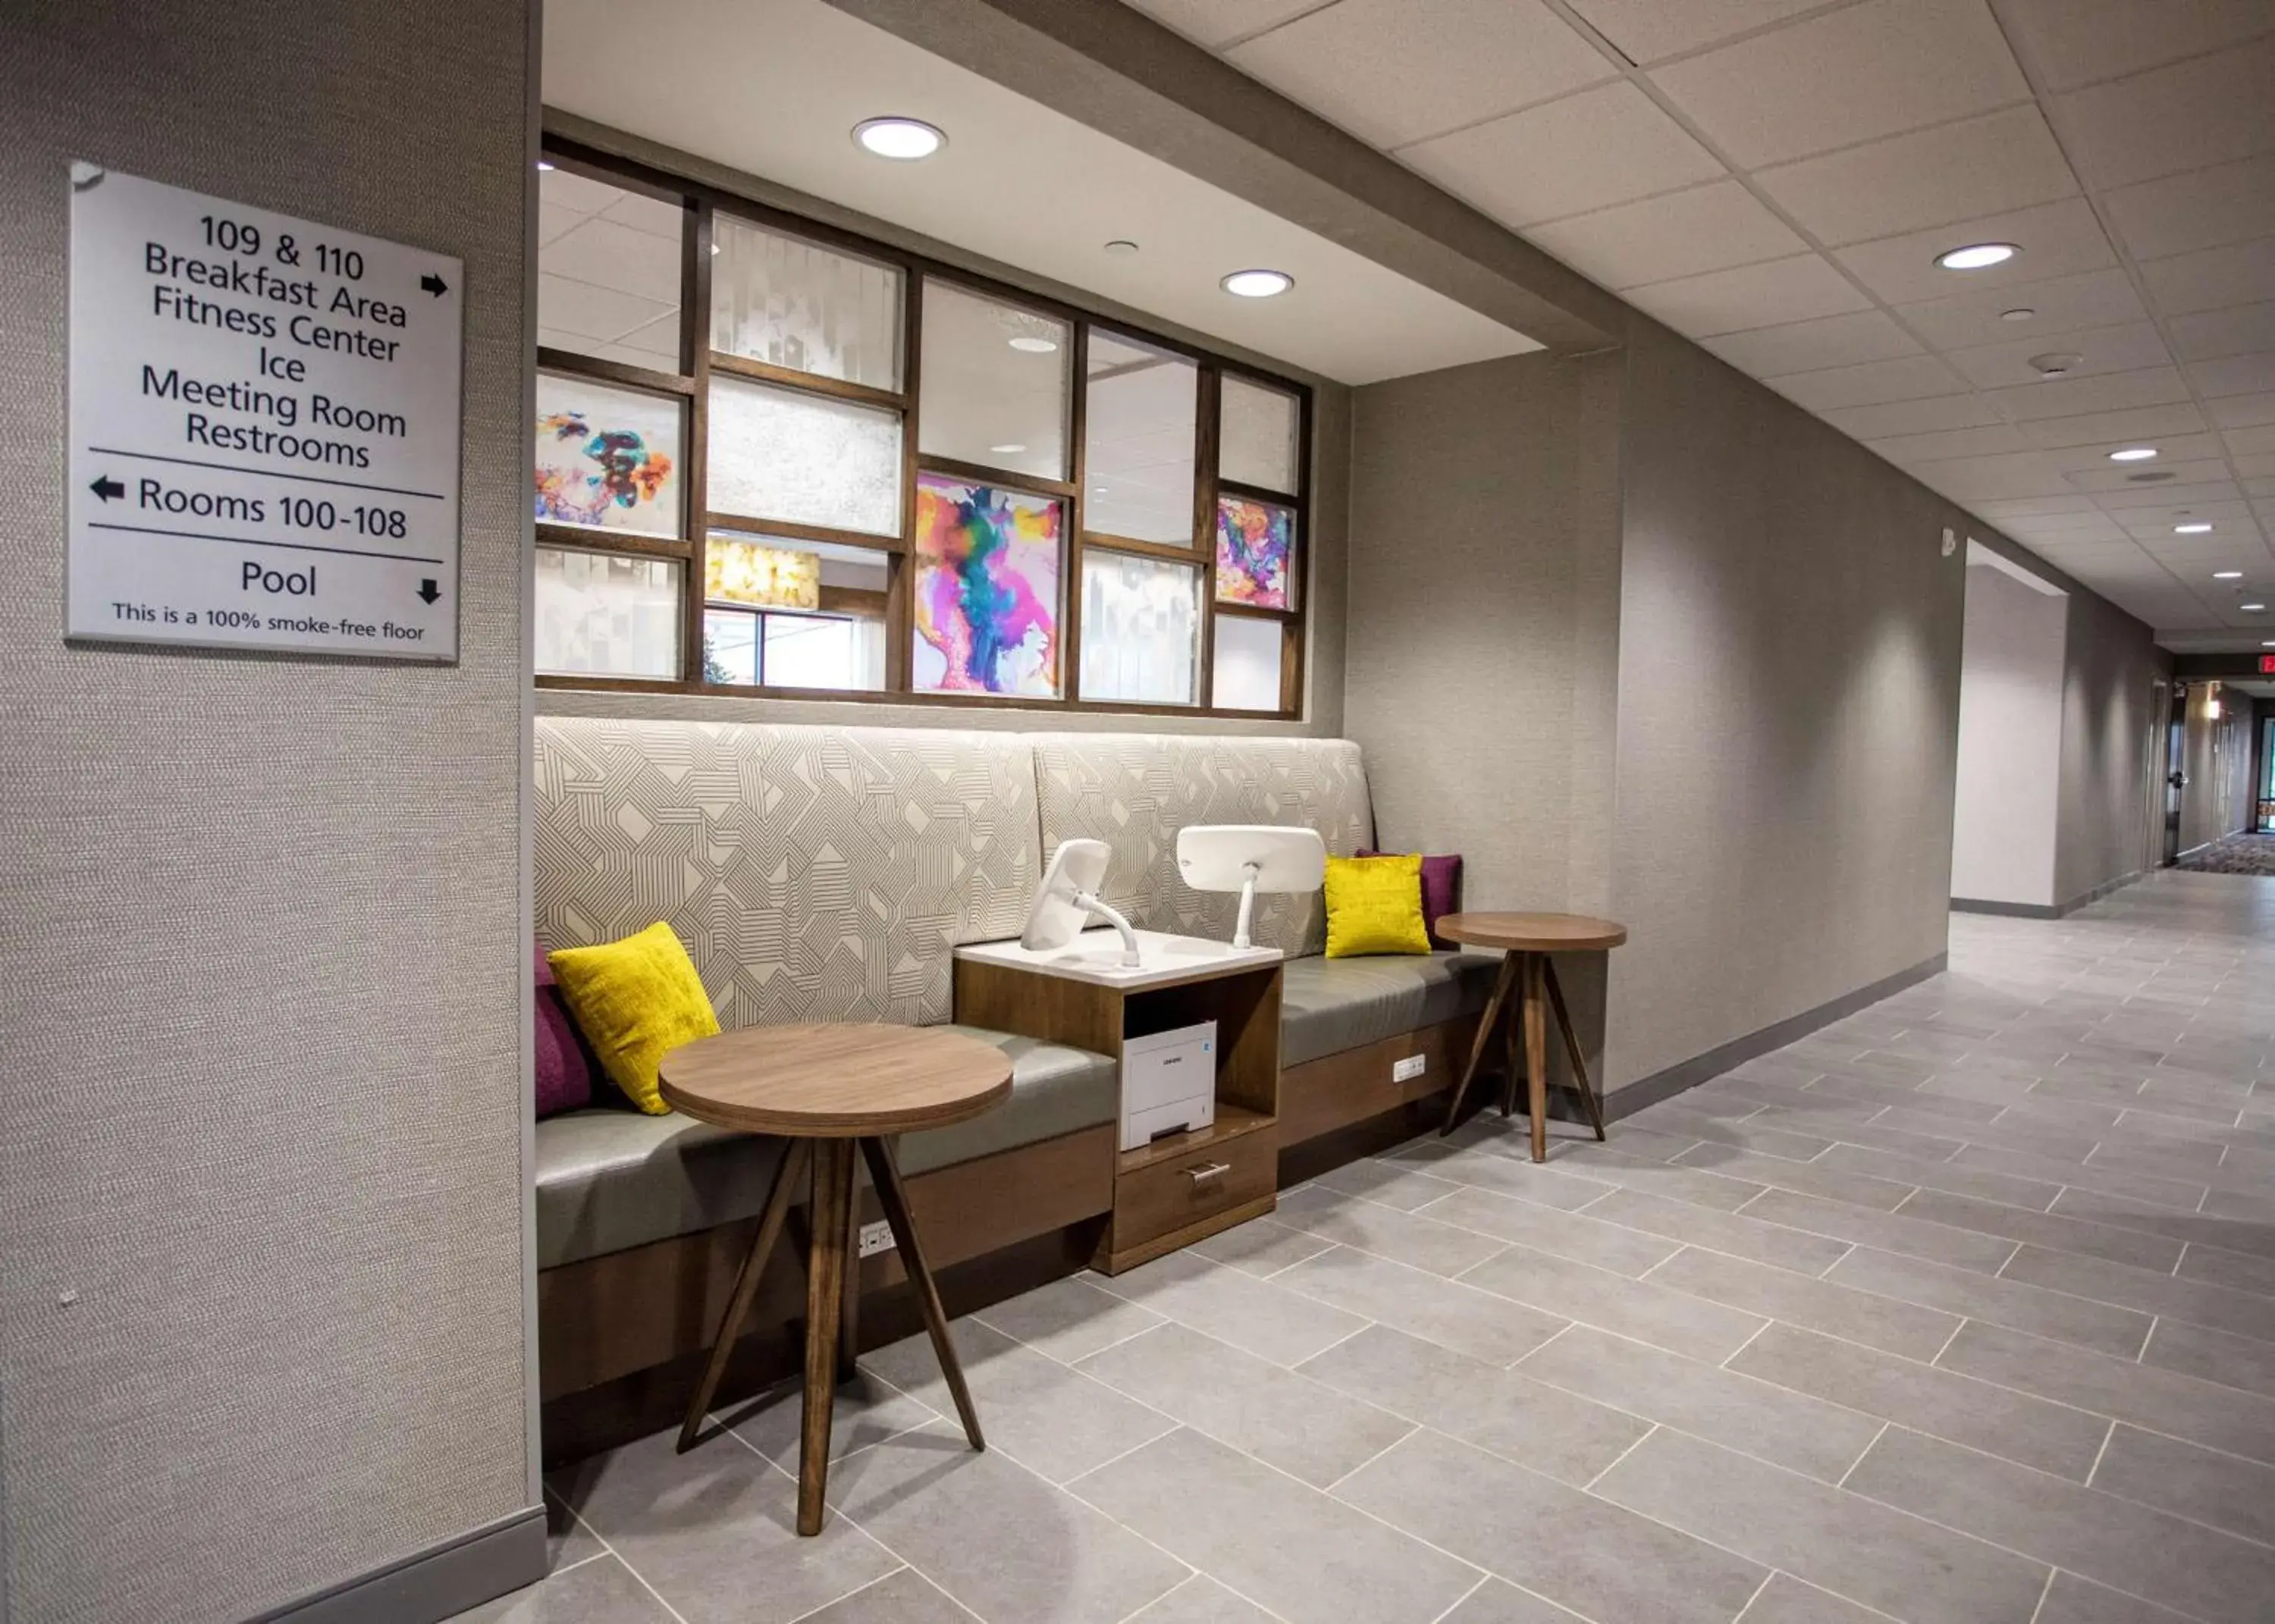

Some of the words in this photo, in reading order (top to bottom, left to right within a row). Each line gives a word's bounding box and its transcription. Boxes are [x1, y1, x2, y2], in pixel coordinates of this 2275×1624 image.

[201, 215, 261, 256] 109
[275, 234, 300, 268] &
[315, 243, 364, 281] 110
[145, 241, 318, 310] Breakfast
[329, 286, 406, 328] Area
[153, 284, 277, 339] Fitness
[289, 315, 400, 362] Center
[260, 346, 306, 383] Ice
[142, 364, 297, 428] Meeting
[312, 393, 406, 437] Room
[187, 412, 370, 469] Restrooms
[140, 477, 265, 523] Rooms
[279, 496, 406, 539] 100-108
[242, 560, 316, 597] Pool
[111, 602, 156, 622] This
[163, 609, 179, 628] is
[185, 612, 198, 625] a
[206, 610, 261, 629] 100%
[268, 616, 377, 638] smoke-free
[381, 621, 425, 641] floor
